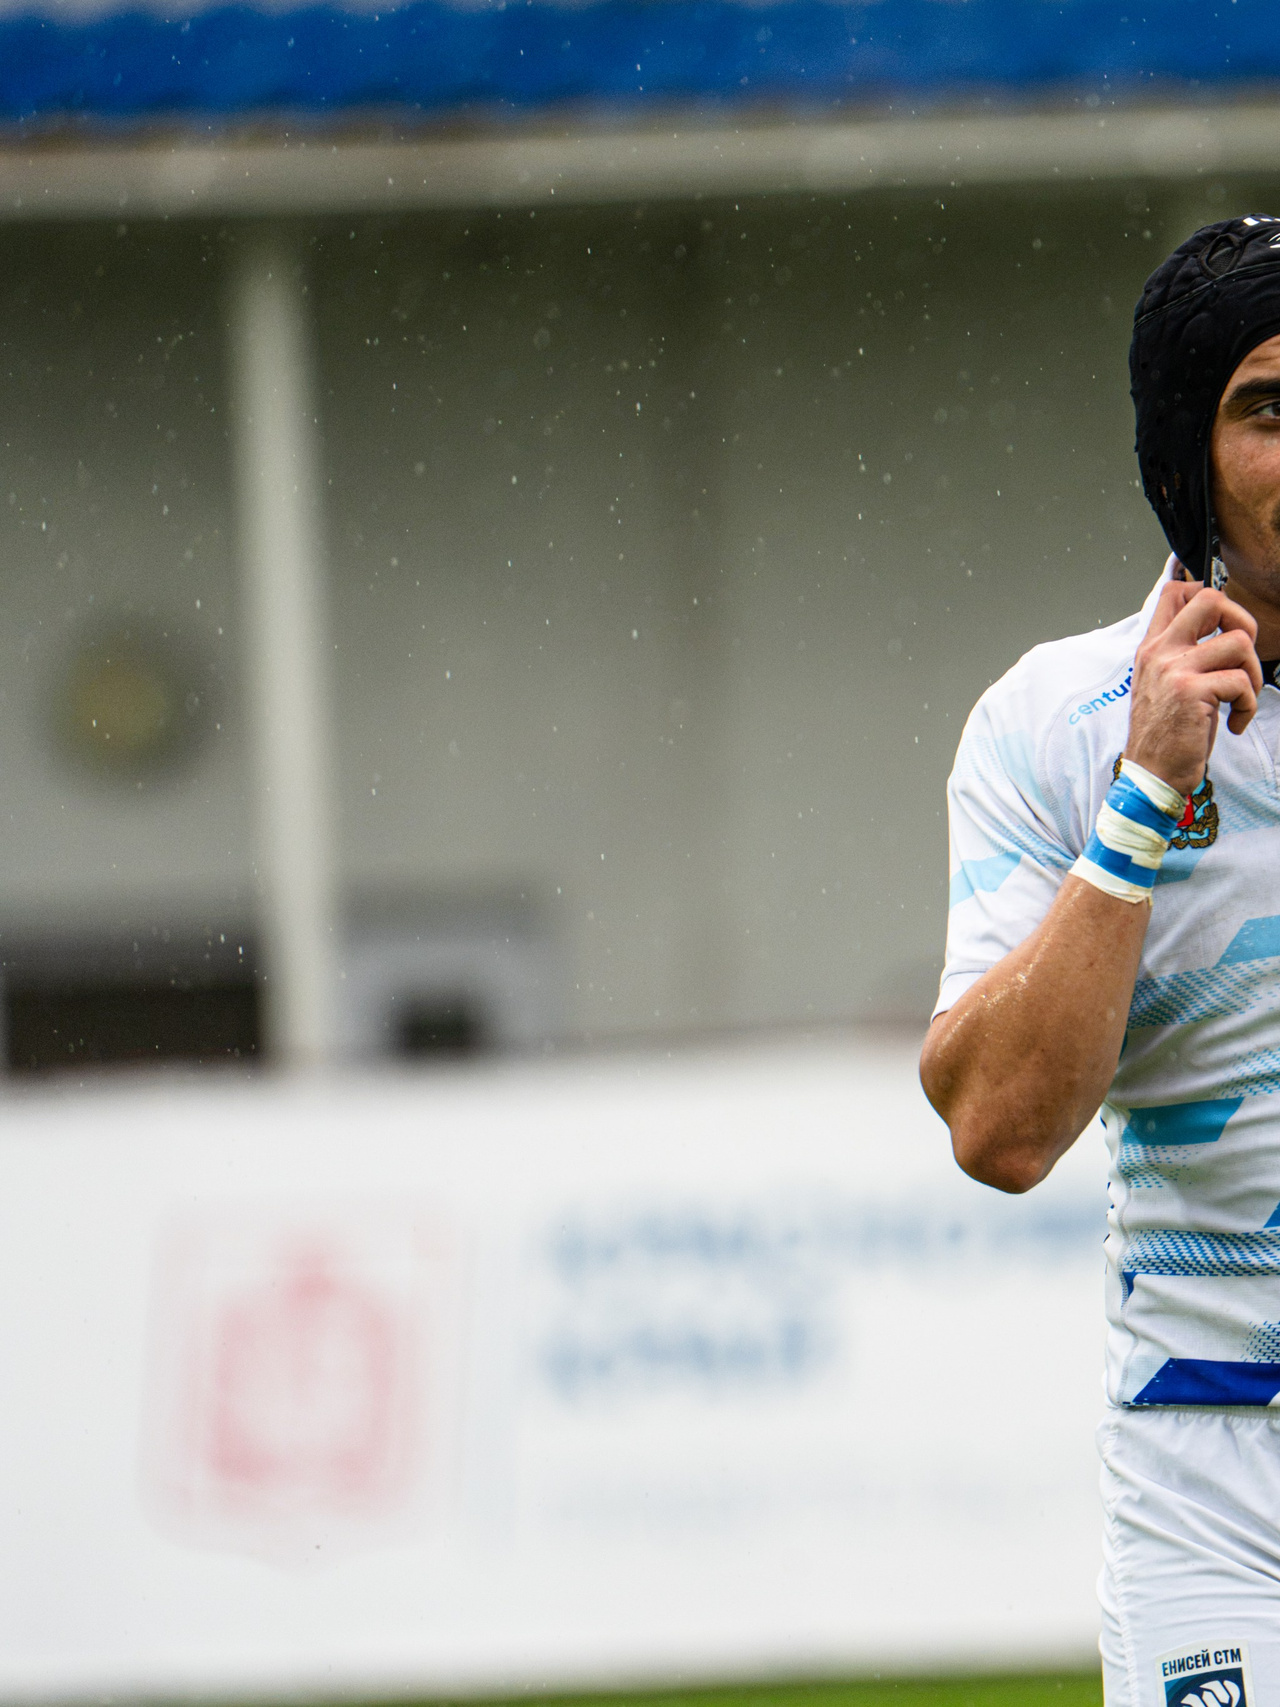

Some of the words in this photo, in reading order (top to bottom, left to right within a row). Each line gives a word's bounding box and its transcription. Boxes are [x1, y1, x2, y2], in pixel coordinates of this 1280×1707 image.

[1068, 667, 1134, 725] centur
[1162, 1649, 1211, 1677] ЕНИСЕЙ
[1213, 1648, 1242, 1665] СТМ
